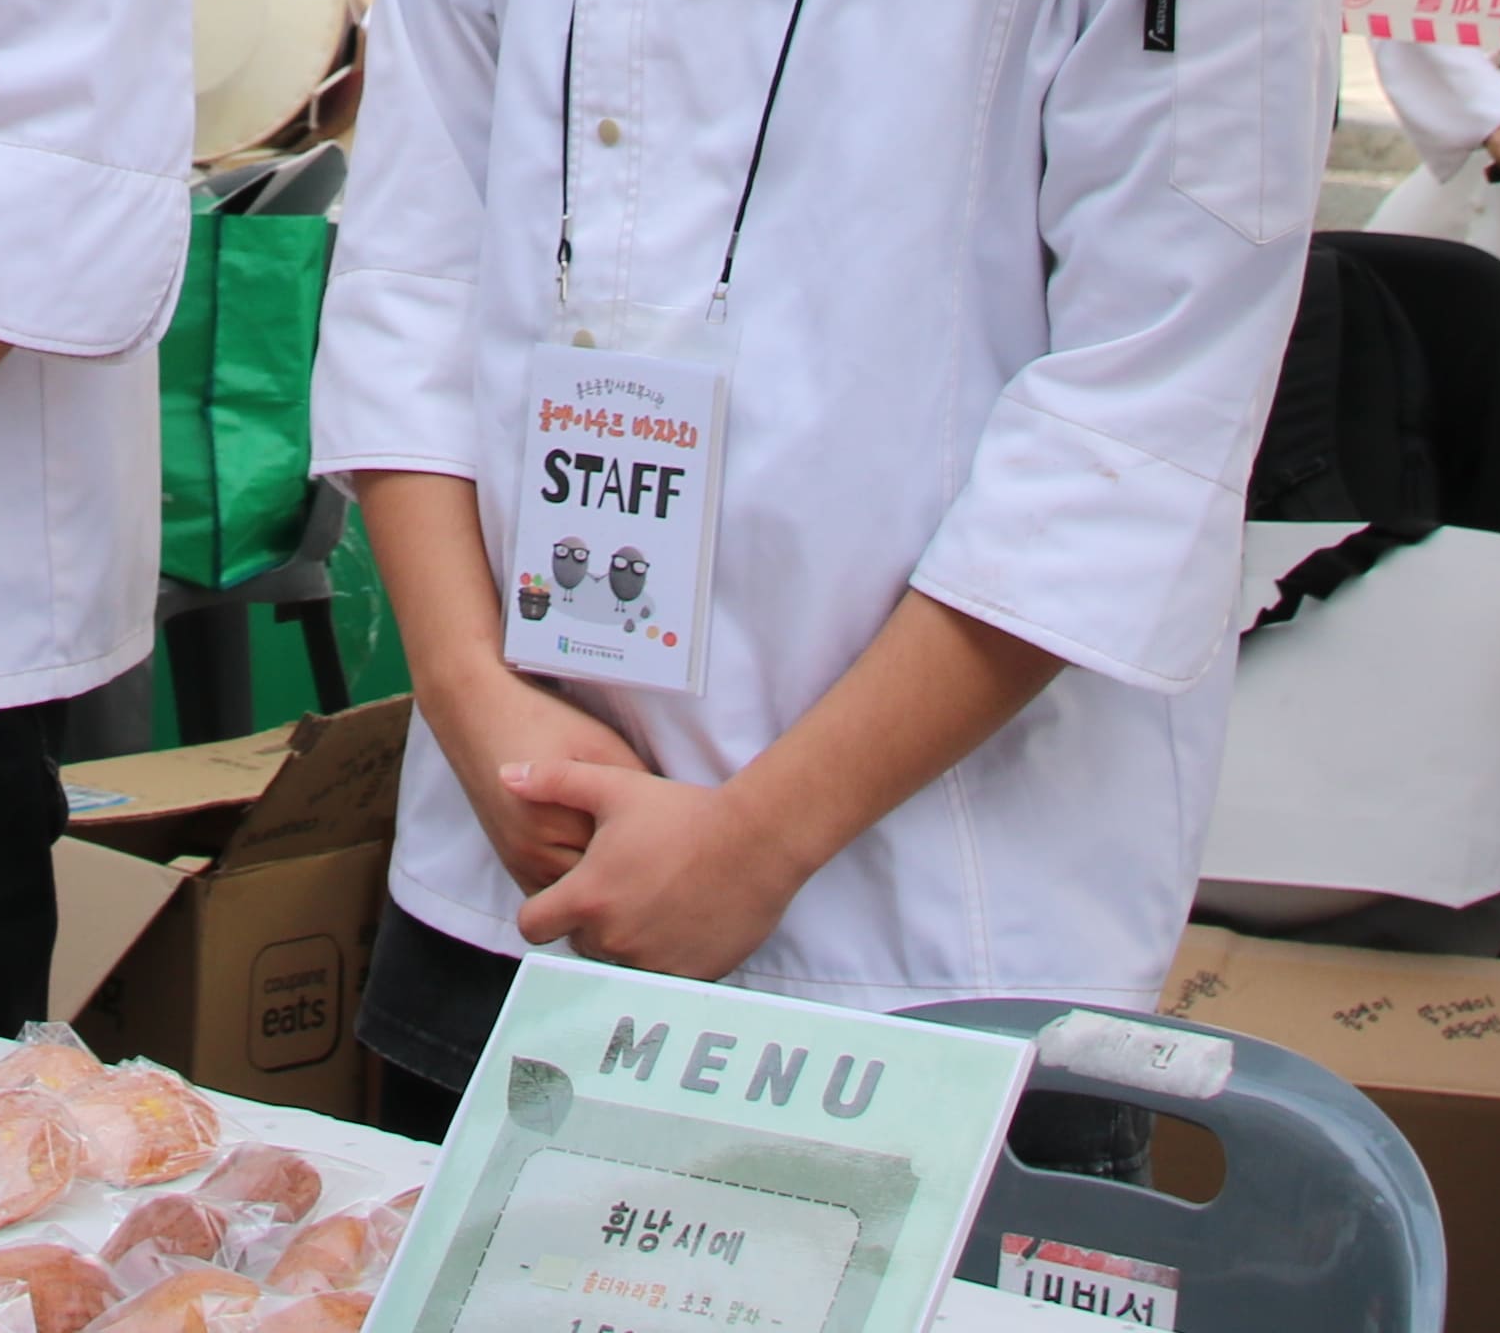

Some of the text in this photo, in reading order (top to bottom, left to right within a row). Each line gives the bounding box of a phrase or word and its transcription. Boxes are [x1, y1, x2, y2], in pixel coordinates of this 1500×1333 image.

[632, 415, 698, 449] 바자회
[541, 448, 685, 519] STAFF
[262, 993, 326, 1038] eats
[600, 1016, 886, 1119] MENU
[602, 1201, 746, 1266] 휘낭시에
